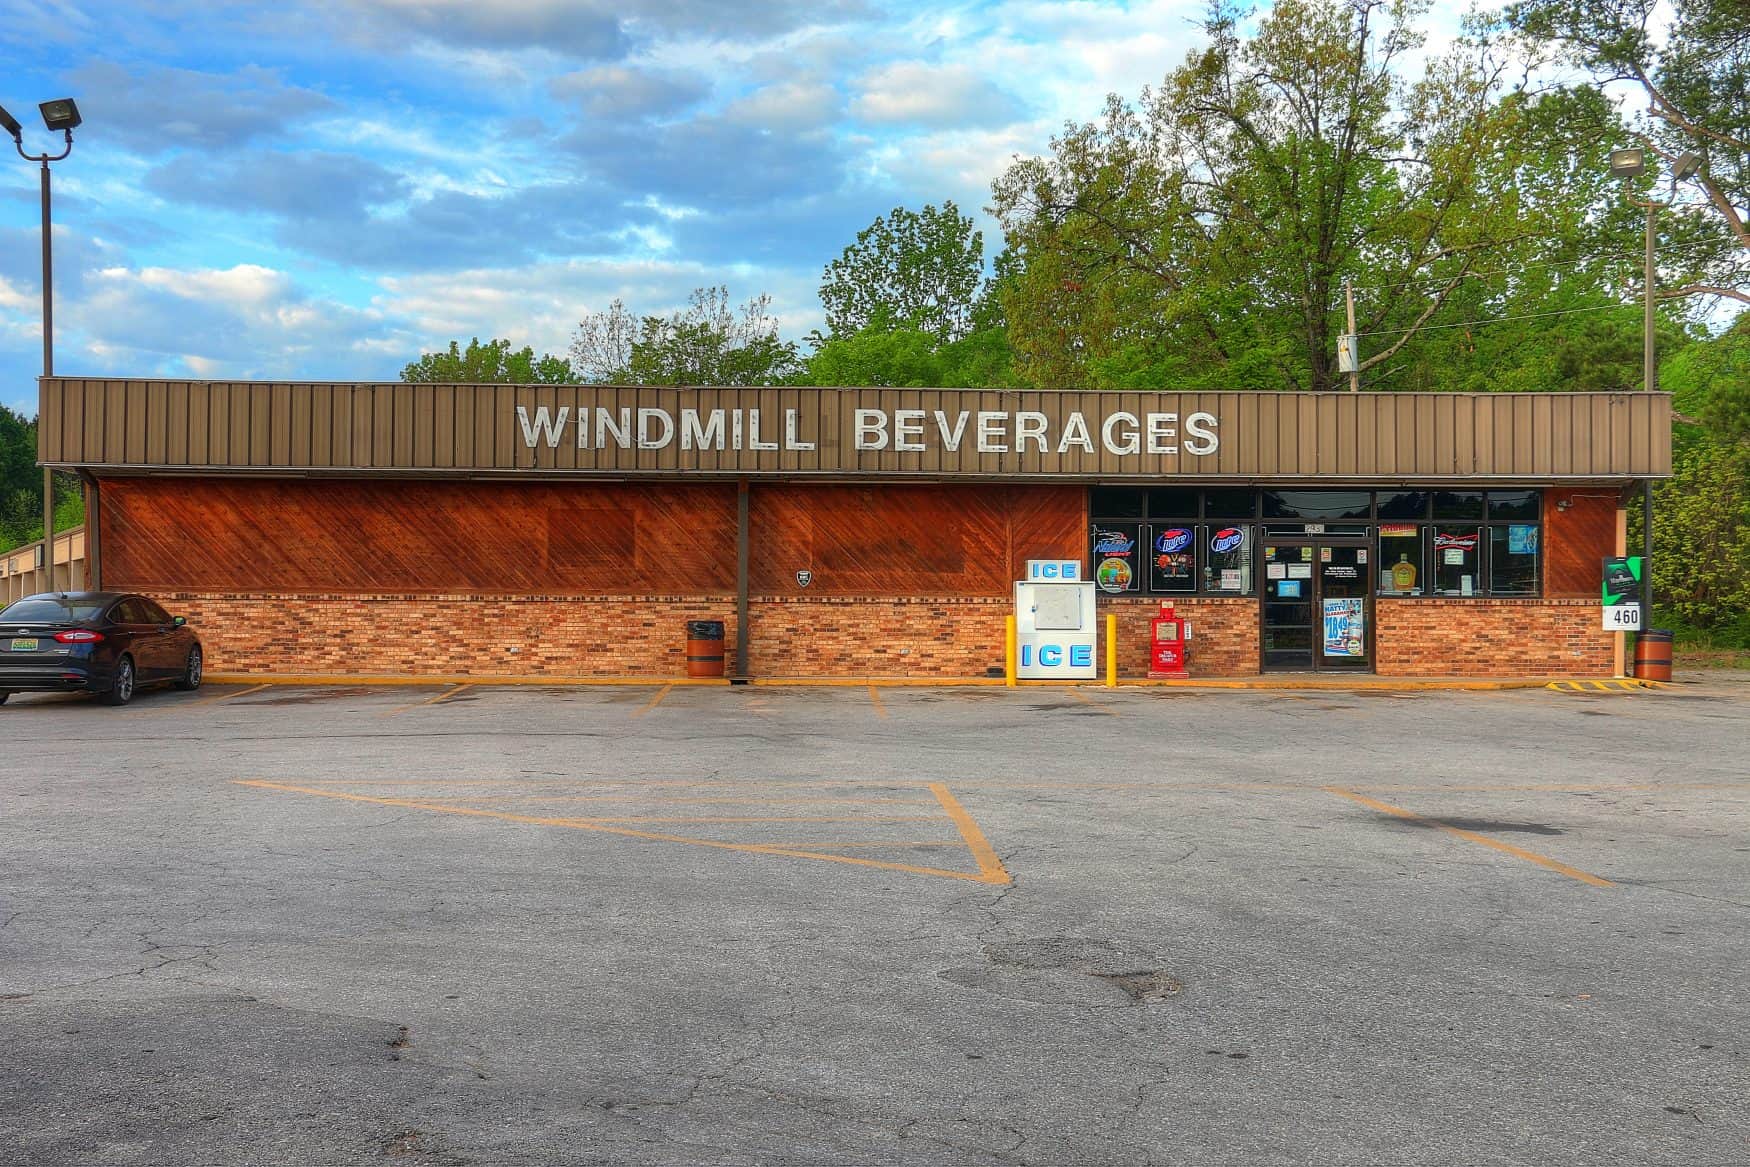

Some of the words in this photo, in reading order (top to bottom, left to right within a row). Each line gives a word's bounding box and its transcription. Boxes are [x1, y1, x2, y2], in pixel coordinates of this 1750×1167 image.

[516, 406, 815, 450] WINDMILL
[854, 408, 1219, 456] BEVERAGES
[1032, 563, 1077, 578] ICE
[1021, 645, 1092, 666] ICE
